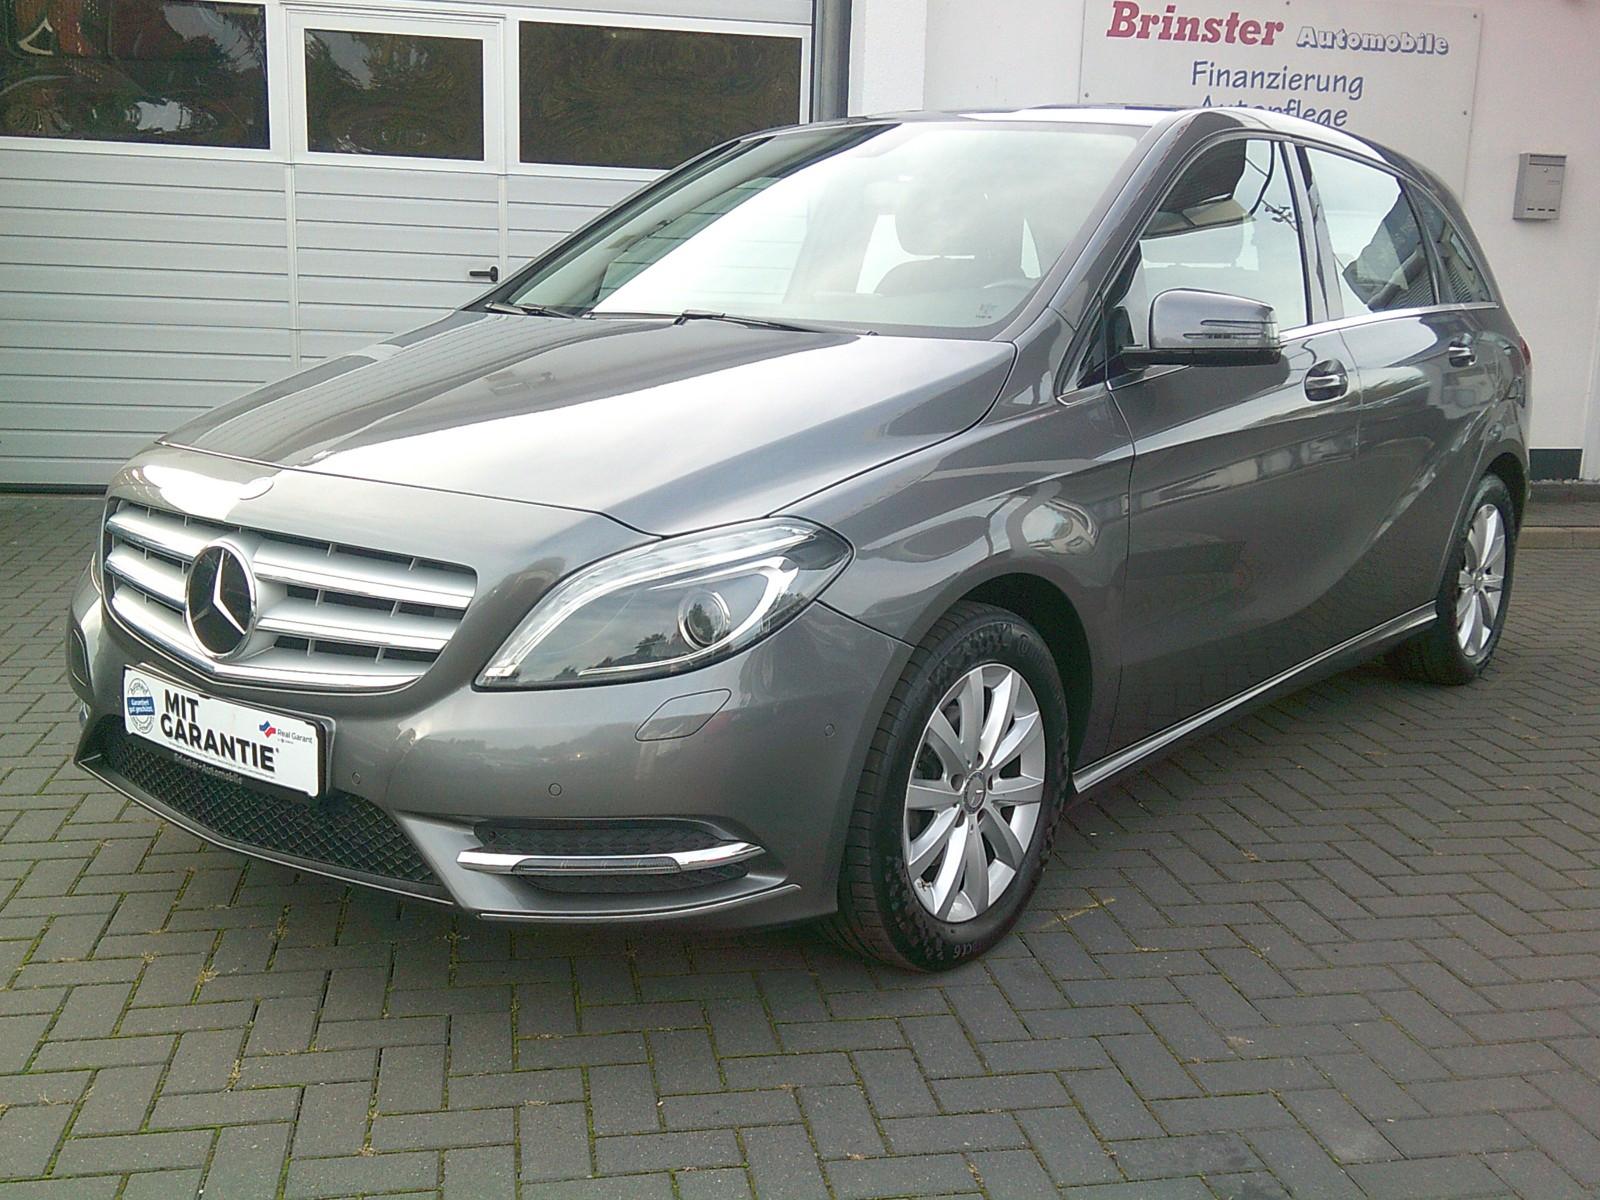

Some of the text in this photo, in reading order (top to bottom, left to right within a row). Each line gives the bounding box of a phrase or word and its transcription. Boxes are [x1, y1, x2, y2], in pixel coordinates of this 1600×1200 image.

[1106, 1, 1449, 55] Brinster Automobile
[1191, 60, 1364, 101] Finanzierung
[1201, 95, 1349, 127] flege
[164, 689, 199, 723] MIT
